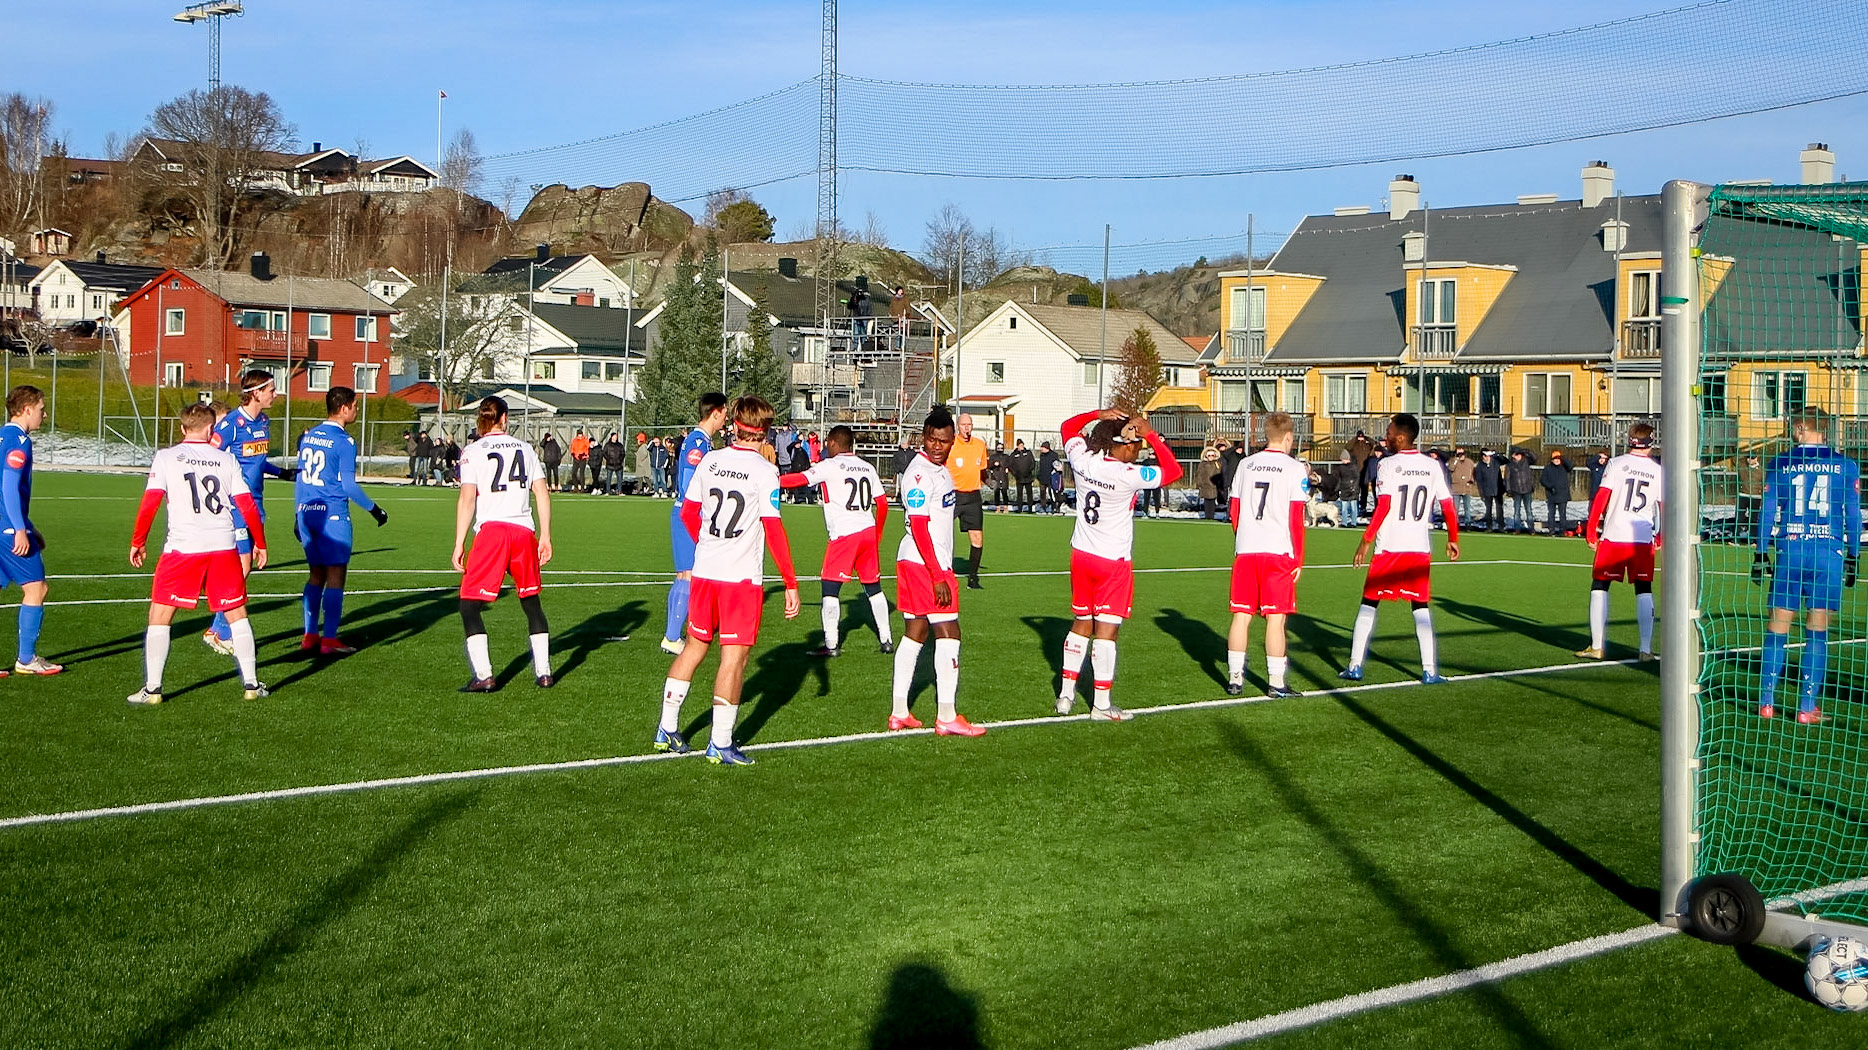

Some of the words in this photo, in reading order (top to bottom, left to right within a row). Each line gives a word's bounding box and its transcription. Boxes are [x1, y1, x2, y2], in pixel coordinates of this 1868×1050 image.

[303, 436, 334, 449] HARMONIE
[490, 442, 522, 450] JOTRON
[185, 459, 221, 467] JOTRON
[301, 447, 326, 487] 32
[487, 449, 528, 493] 24
[714, 470, 750, 481] JOTRON
[1252, 465, 1283, 473] JOTRON
[1628, 470, 1655, 479] JOTRON
[1782, 463, 1841, 474] HARMONIE
[184, 472, 224, 515] 18
[844, 476, 873, 512] 20
[1084, 478, 1116, 491] JOTRON
[1254, 481, 1270, 521] 7
[1624, 478, 1650, 513] 15
[1791, 474, 1829, 517] 14
[709, 487, 746, 539] 22
[1083, 490, 1101, 525] 8
[1398, 484, 1428, 522] 10
